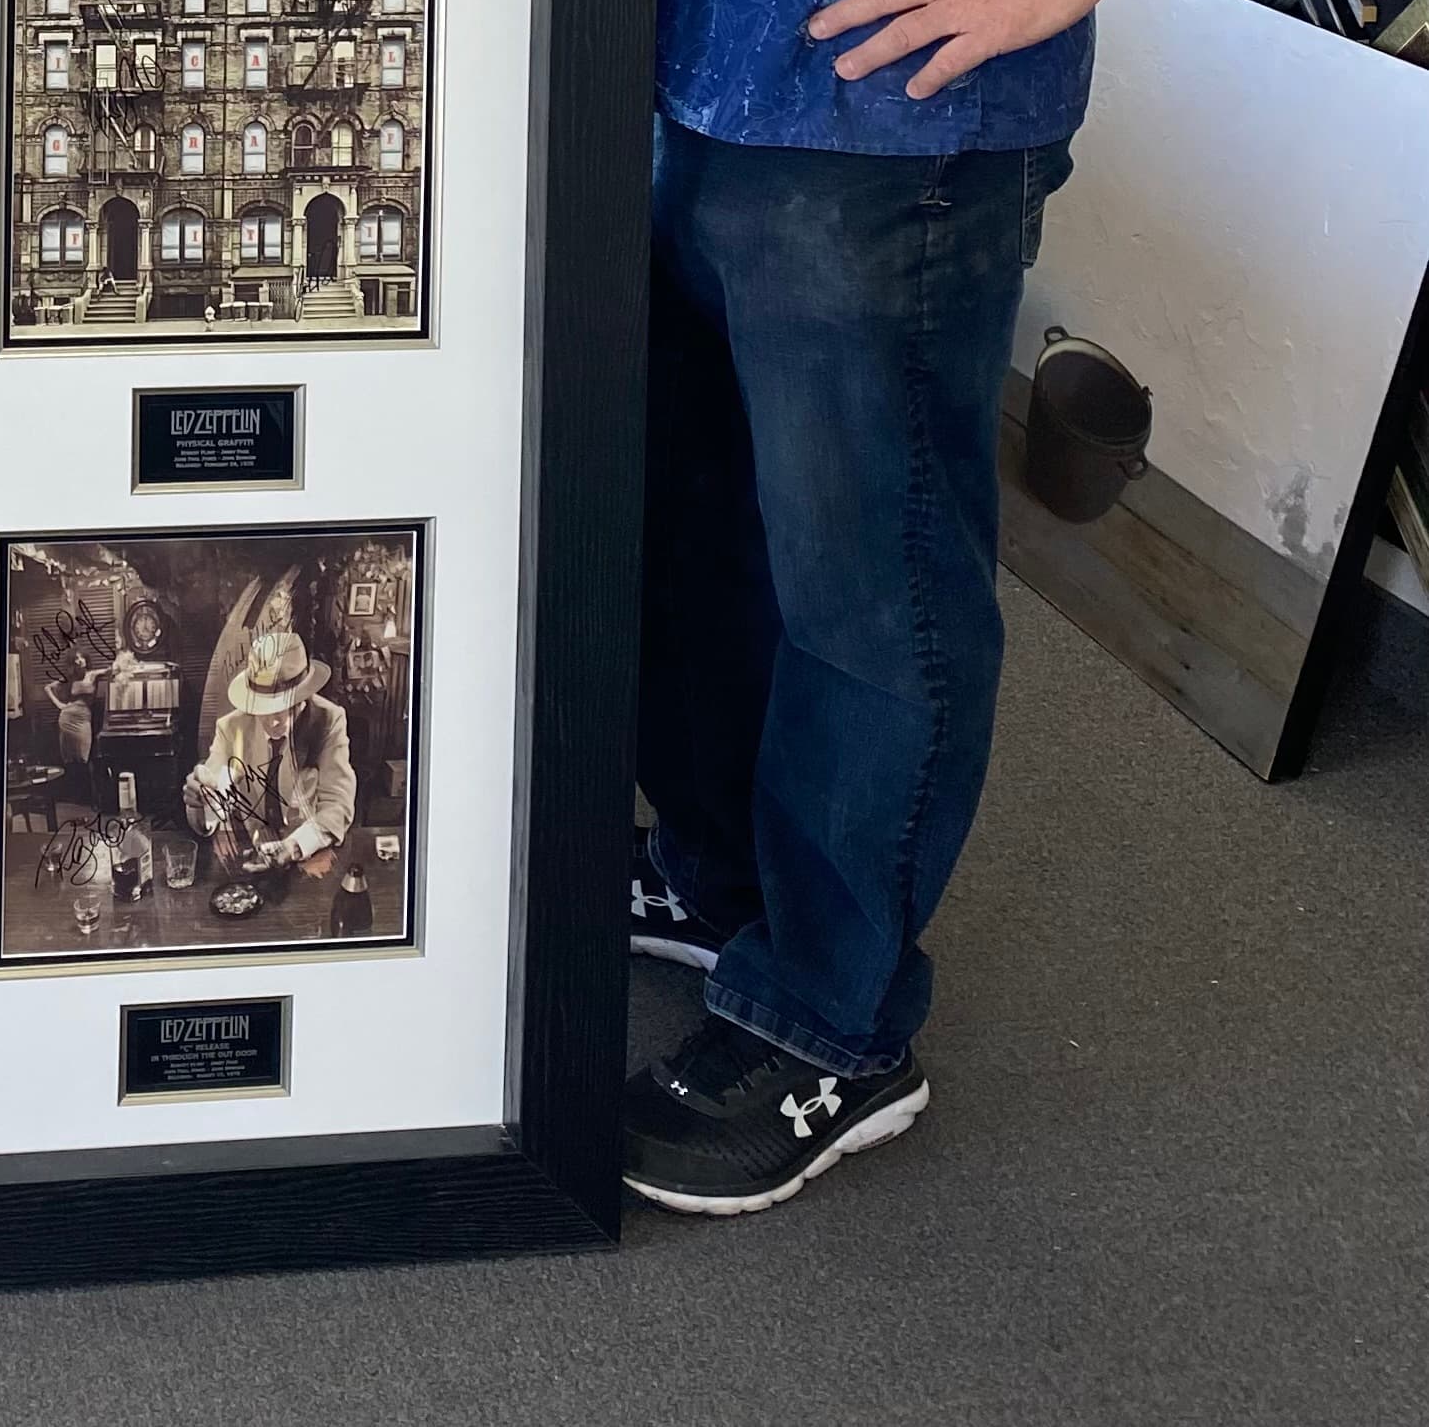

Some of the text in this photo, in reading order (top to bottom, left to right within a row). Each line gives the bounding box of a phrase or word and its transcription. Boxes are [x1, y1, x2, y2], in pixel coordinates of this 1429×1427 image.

[251, 55, 260, 67] A
[388, 51, 396, 63] L
[250, 135, 259, 148] A
[170, 408, 260, 435] LED ZEPPELIN
[176, 440, 216, 448] PHYSICAL
[160, 1015, 249, 1043] LED ZEPPELIN
